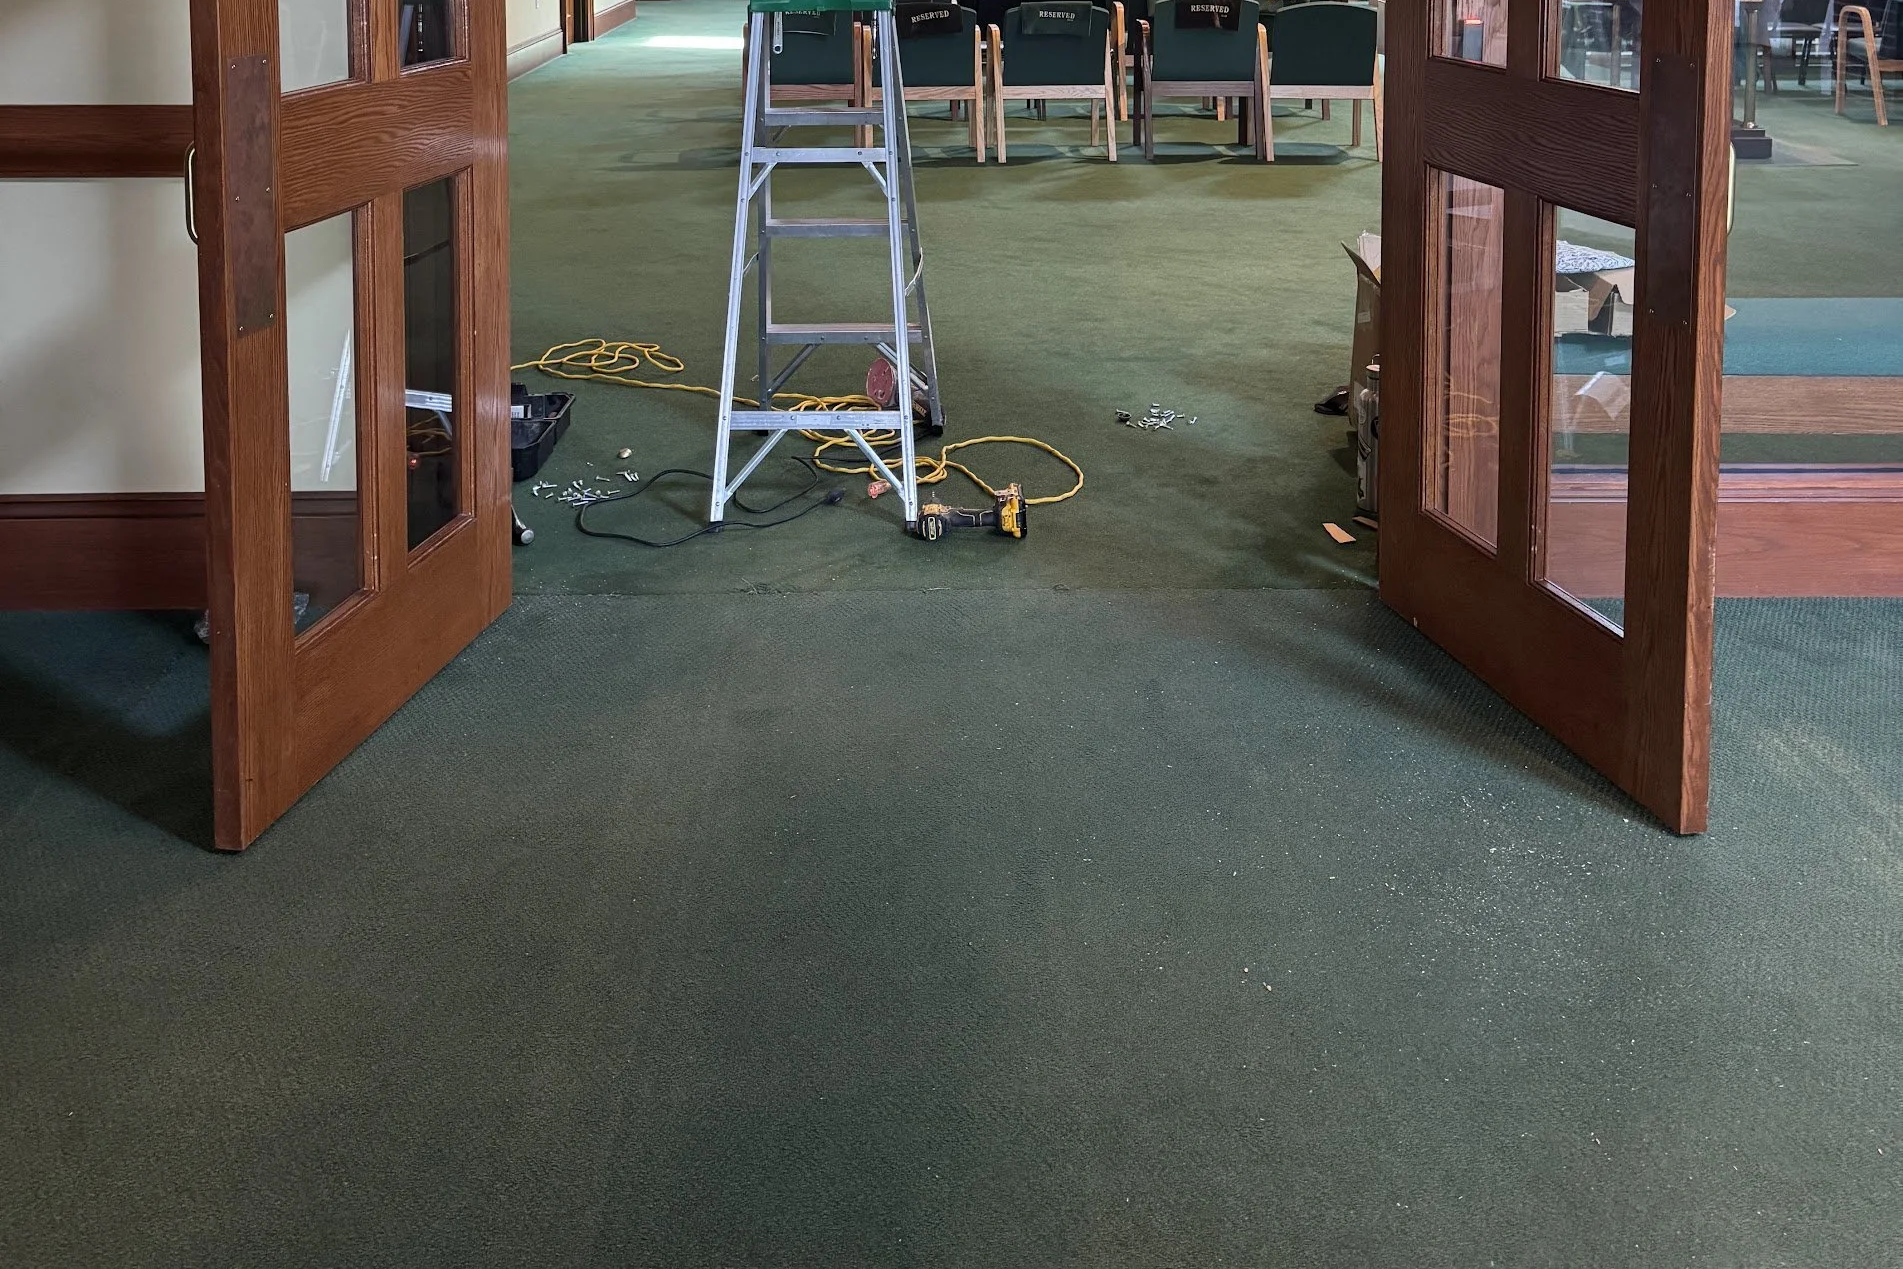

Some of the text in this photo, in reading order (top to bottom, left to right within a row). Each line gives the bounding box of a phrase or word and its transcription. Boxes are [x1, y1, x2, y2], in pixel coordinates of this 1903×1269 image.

[1190, 4, 1230, 13] RESERVED
[911, 10, 950, 23] RESERVED
[1039, 10, 1076, 19] RESERVED
